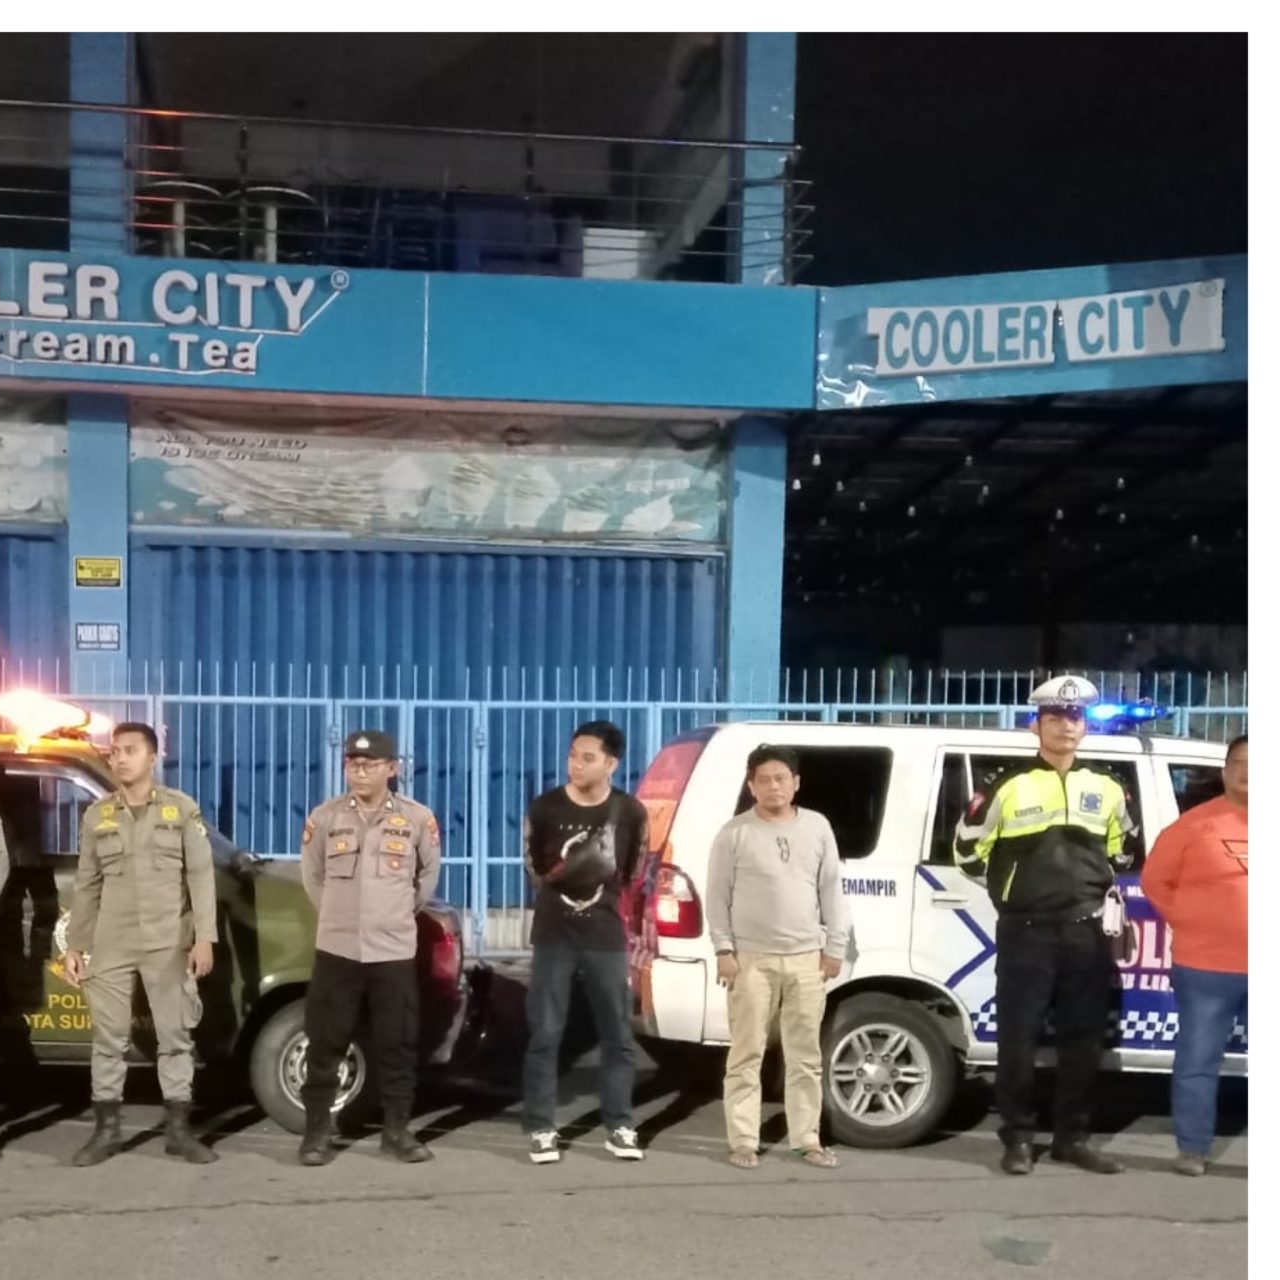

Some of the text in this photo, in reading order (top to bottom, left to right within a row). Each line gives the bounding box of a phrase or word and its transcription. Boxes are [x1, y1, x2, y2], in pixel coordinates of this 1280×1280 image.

[151, 268, 316, 331] CITY
[884, 288, 1192, 370] COOLER CITY
[841, 877, 897, 897] EMAMPIR
[48, 993, 88, 1010] POL
[59, 1013, 92, 1030] SU
